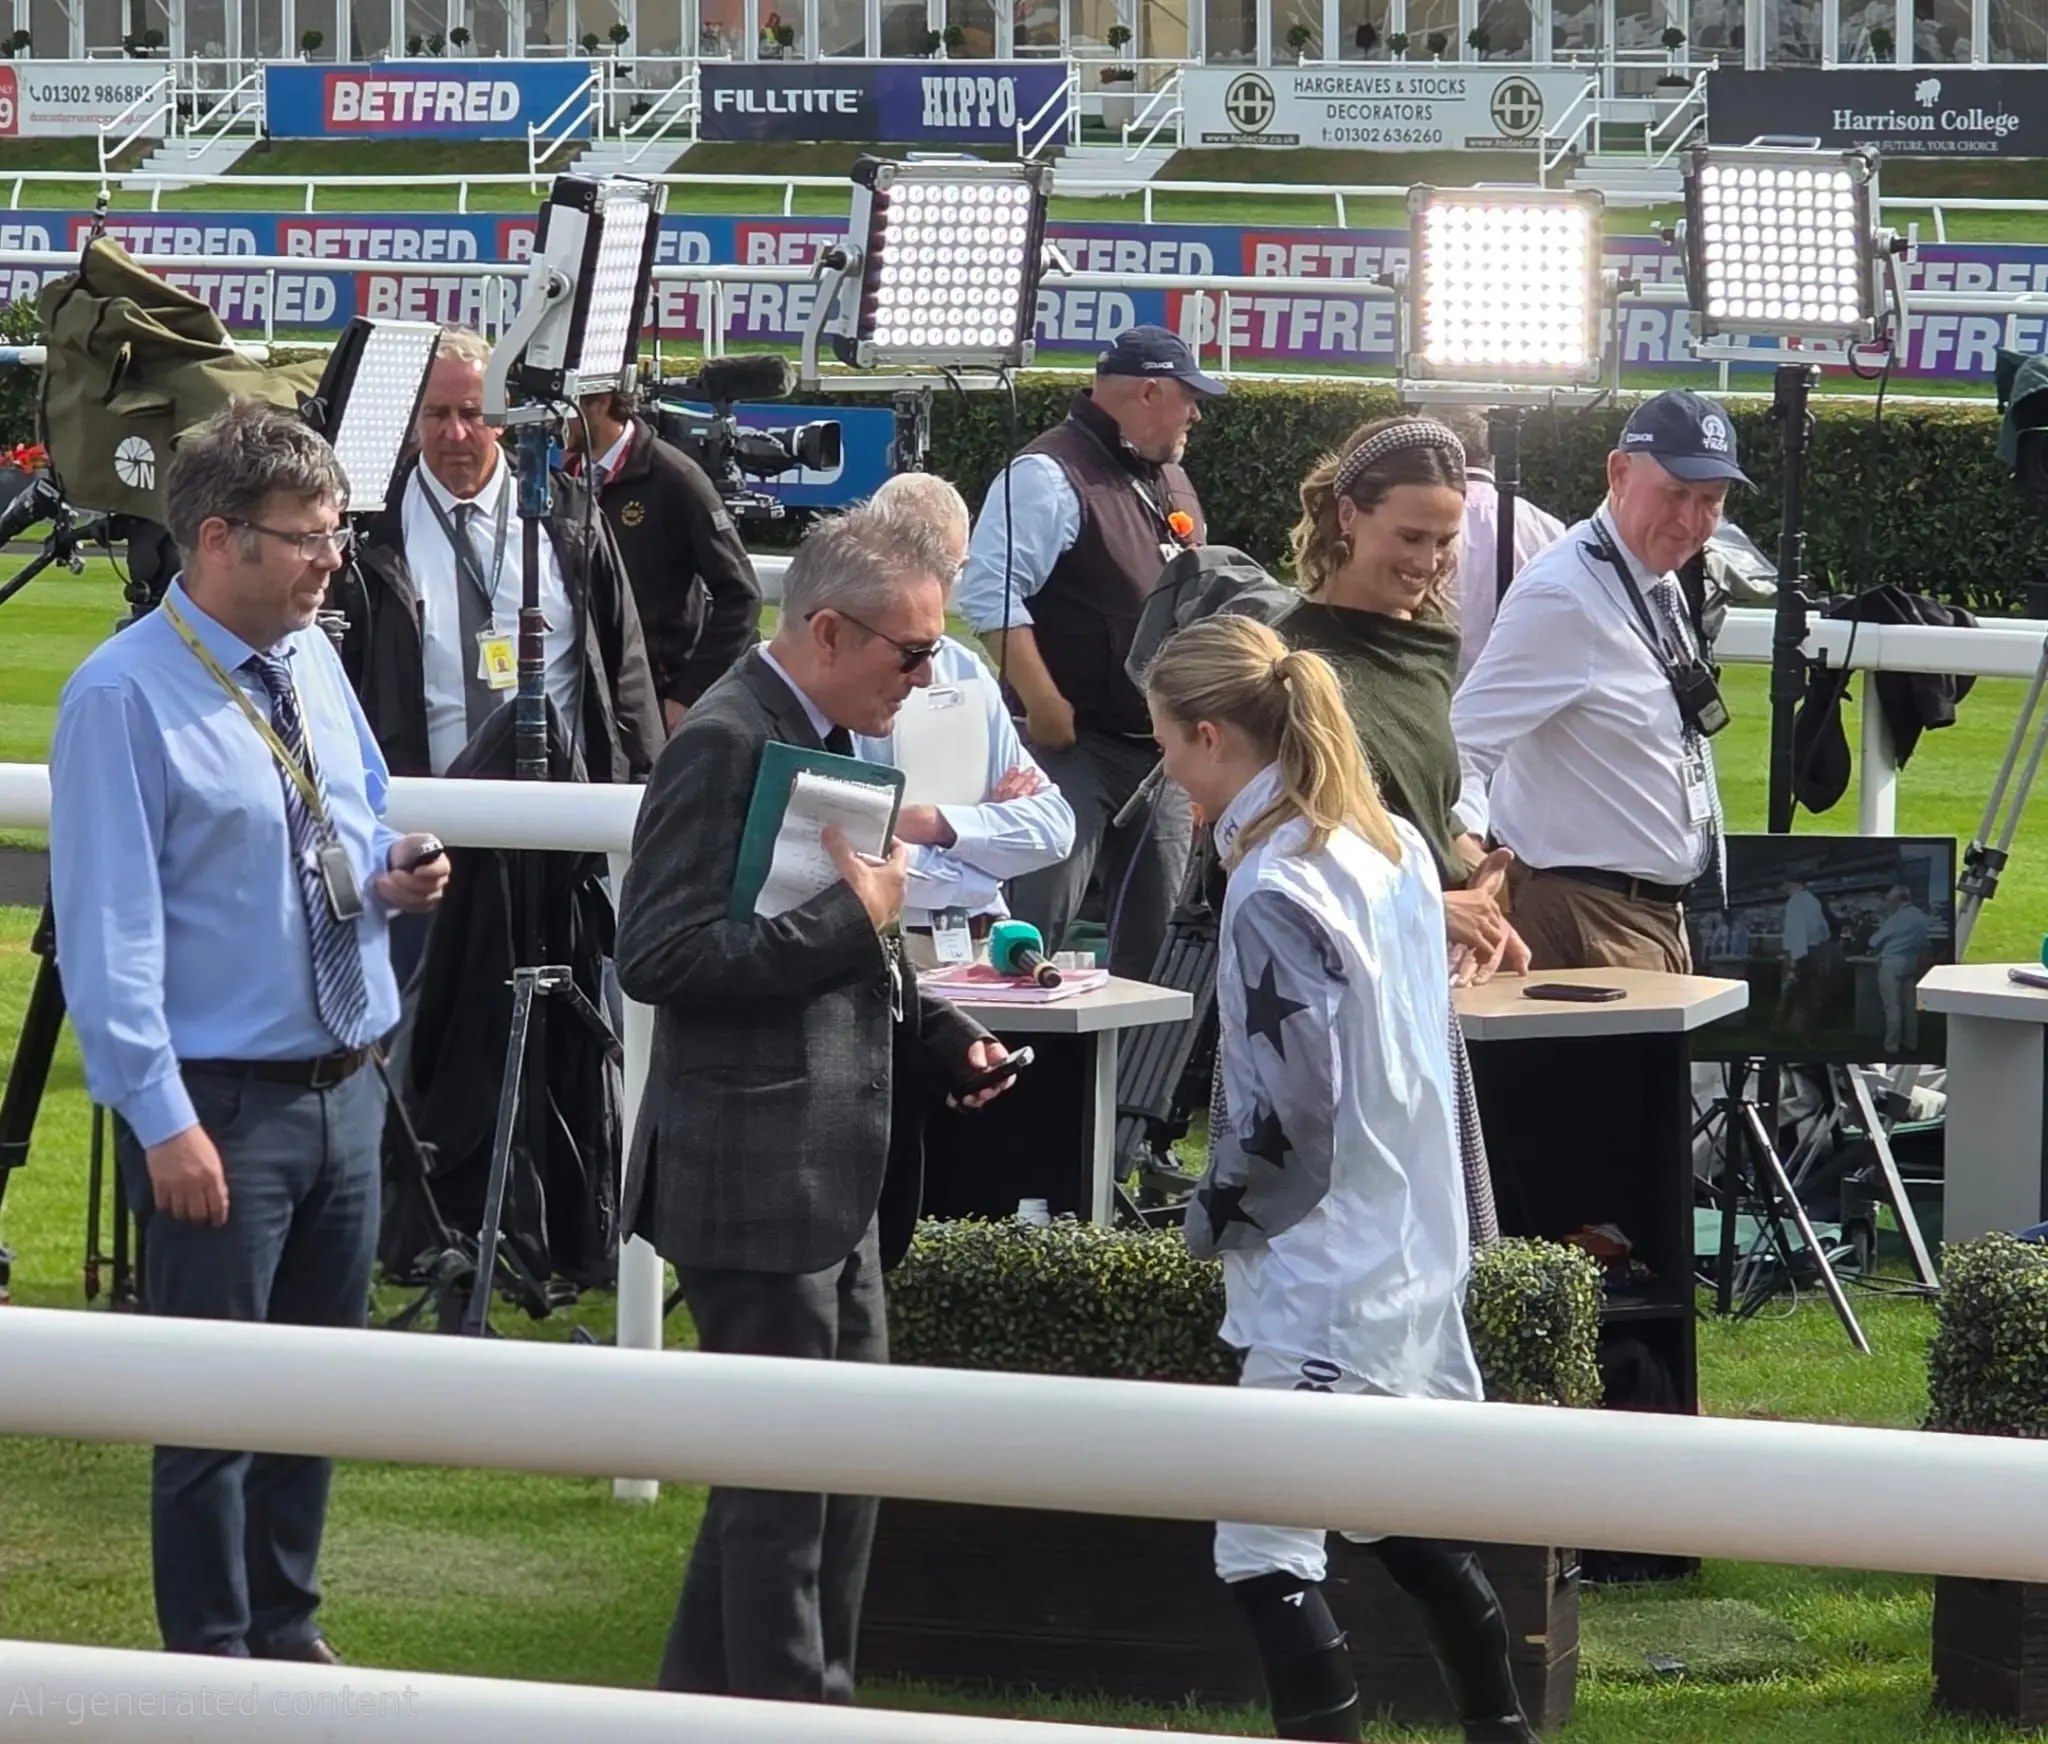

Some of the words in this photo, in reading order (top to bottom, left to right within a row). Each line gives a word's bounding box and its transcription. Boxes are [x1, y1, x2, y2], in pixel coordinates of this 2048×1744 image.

[42, 85, 90, 103] 01302
[1294, 77, 1390, 94] HARGREAVES
[1396, 79, 1405, 94] &
[1409, 79, 1466, 95] STOCKS
[331, 81, 520, 121] BETFRED
[713, 89, 859, 113] FILLTITE
[921, 77, 1016, 127] HIPPO
[1326, 104, 1433, 121] DECORATORS
[1833, 110, 1935, 130] Harrison
[1940, 109, 2020, 137] College
[1383, 128, 1442, 143] 636260
